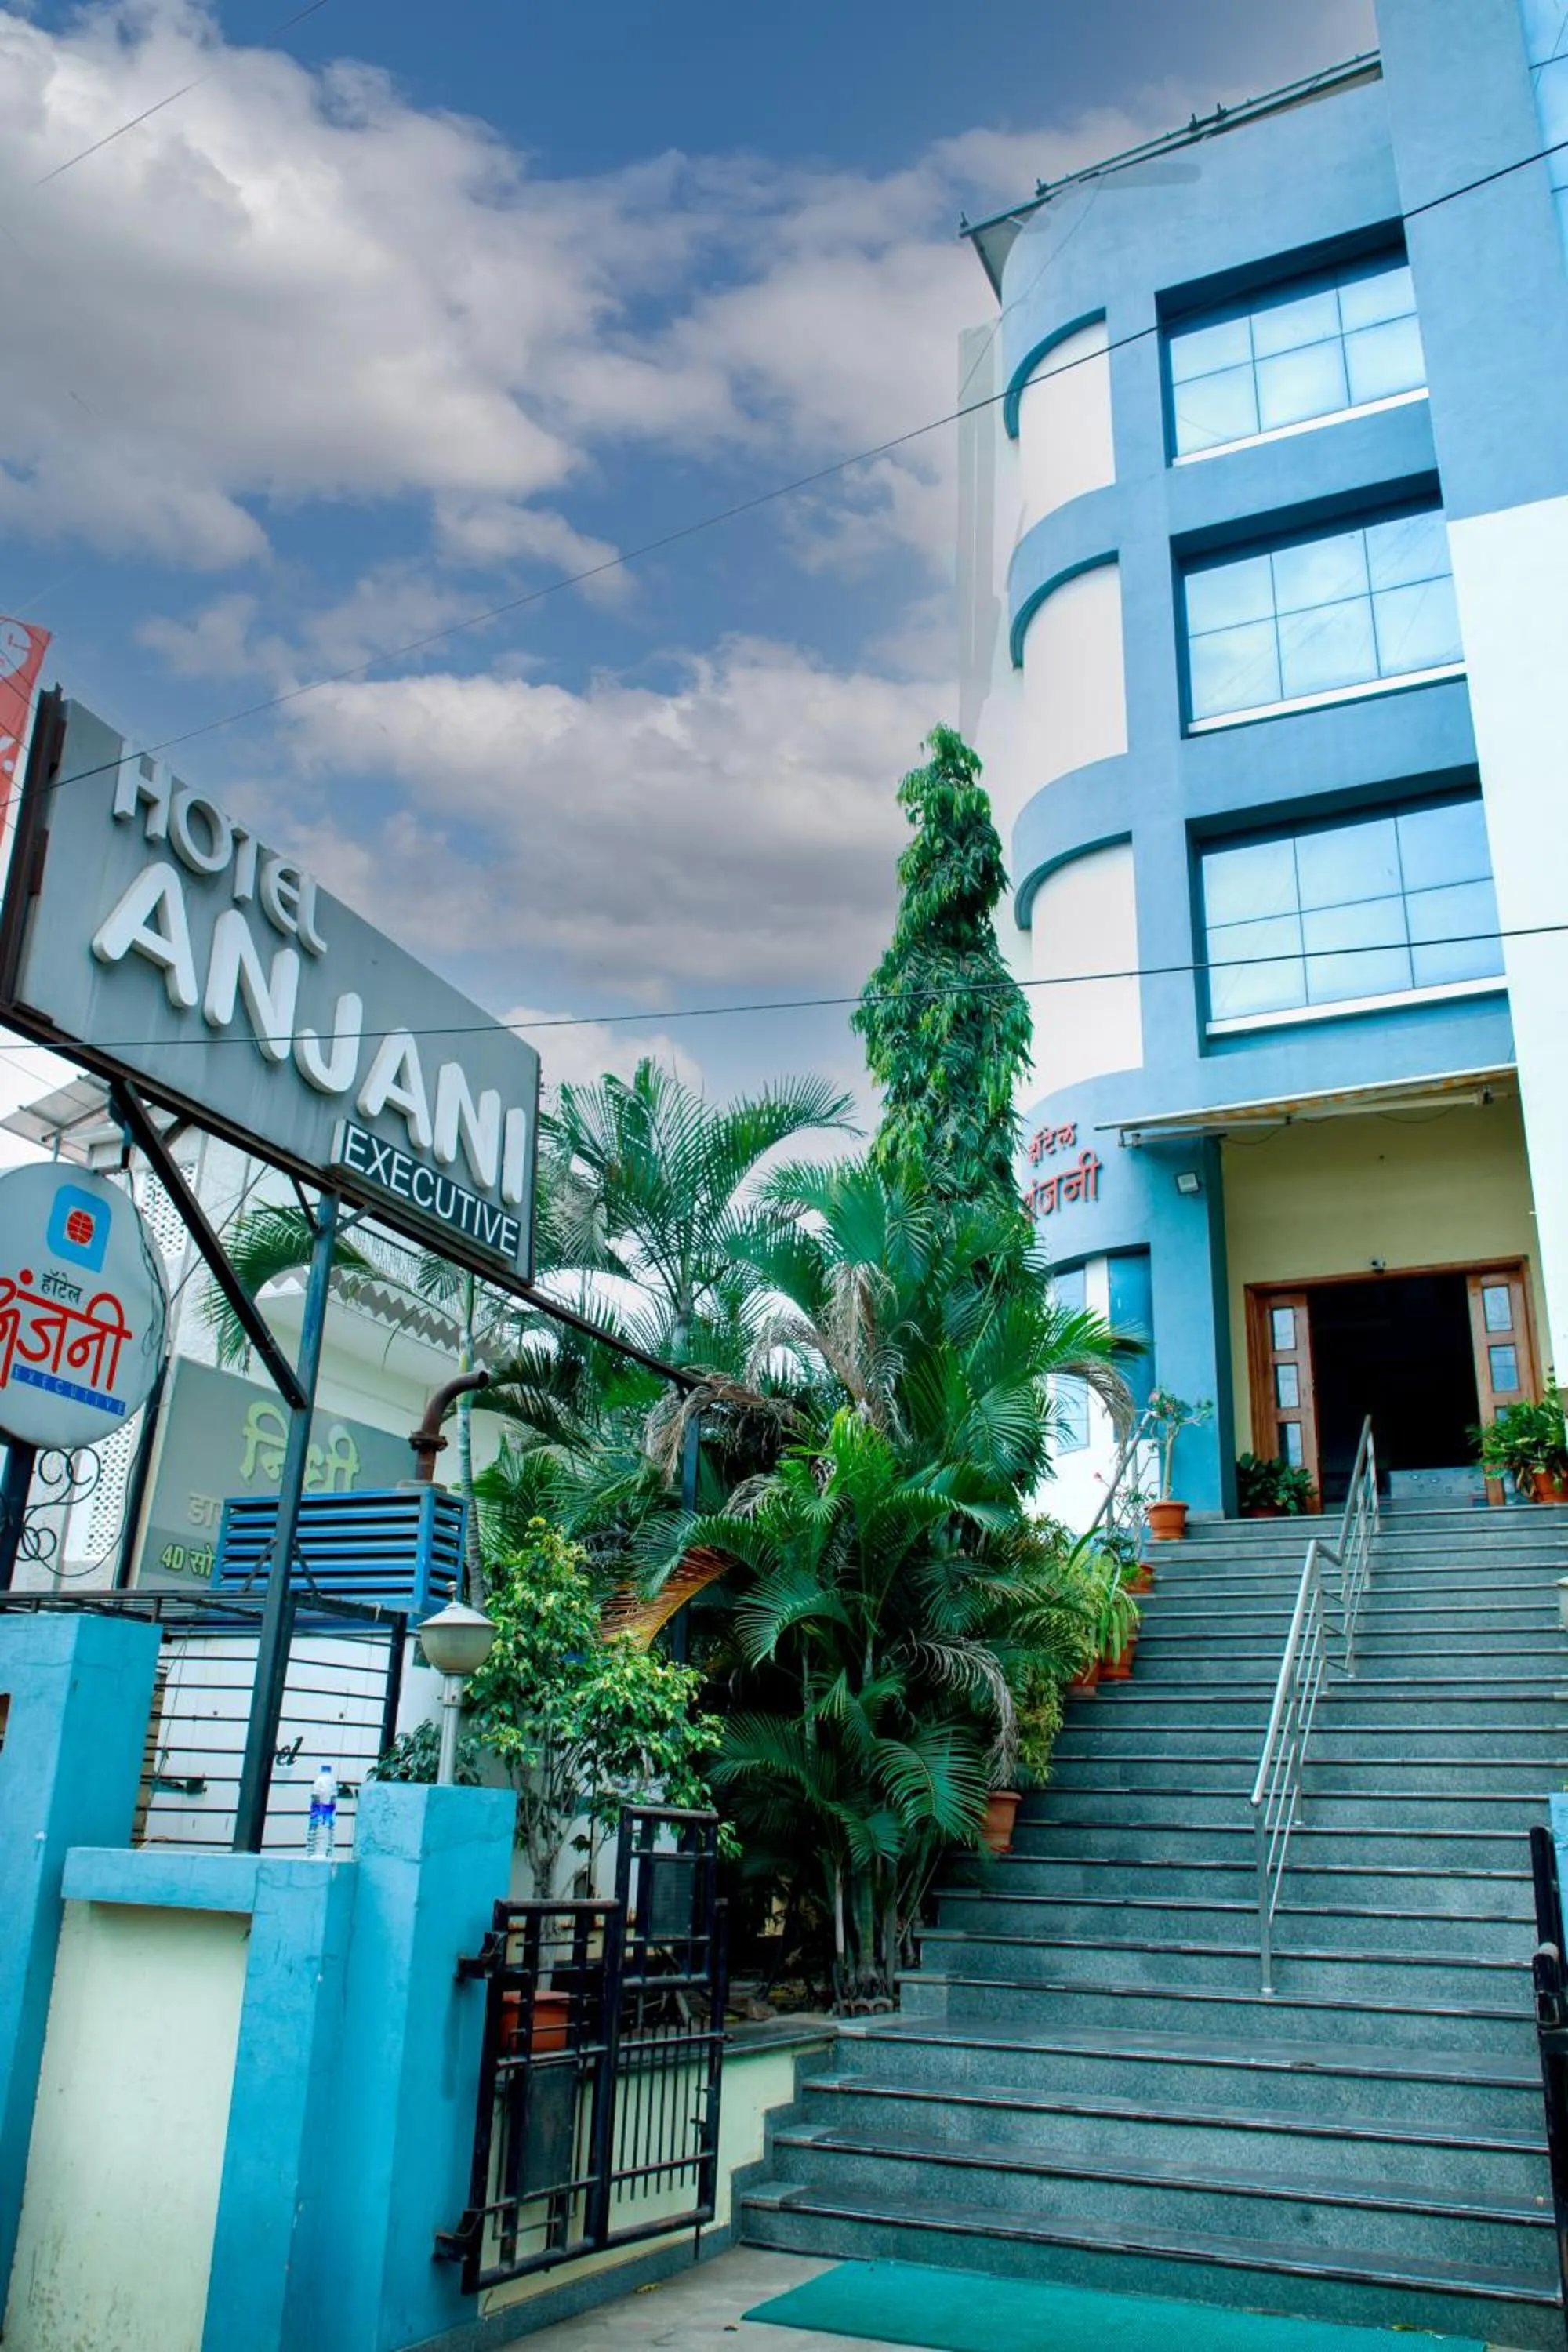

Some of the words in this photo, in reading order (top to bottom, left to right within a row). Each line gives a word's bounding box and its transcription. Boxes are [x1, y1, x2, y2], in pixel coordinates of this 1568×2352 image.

[92, 862, 525, 1205] ANJANI
[343, 1124, 519, 1258] EXECUTIVE
[41, 1269, 83, 1305] हॉटेल
[13, 1365, 125, 1416] EXECUTIVE
[162, 1543, 186, 1570] 4D
